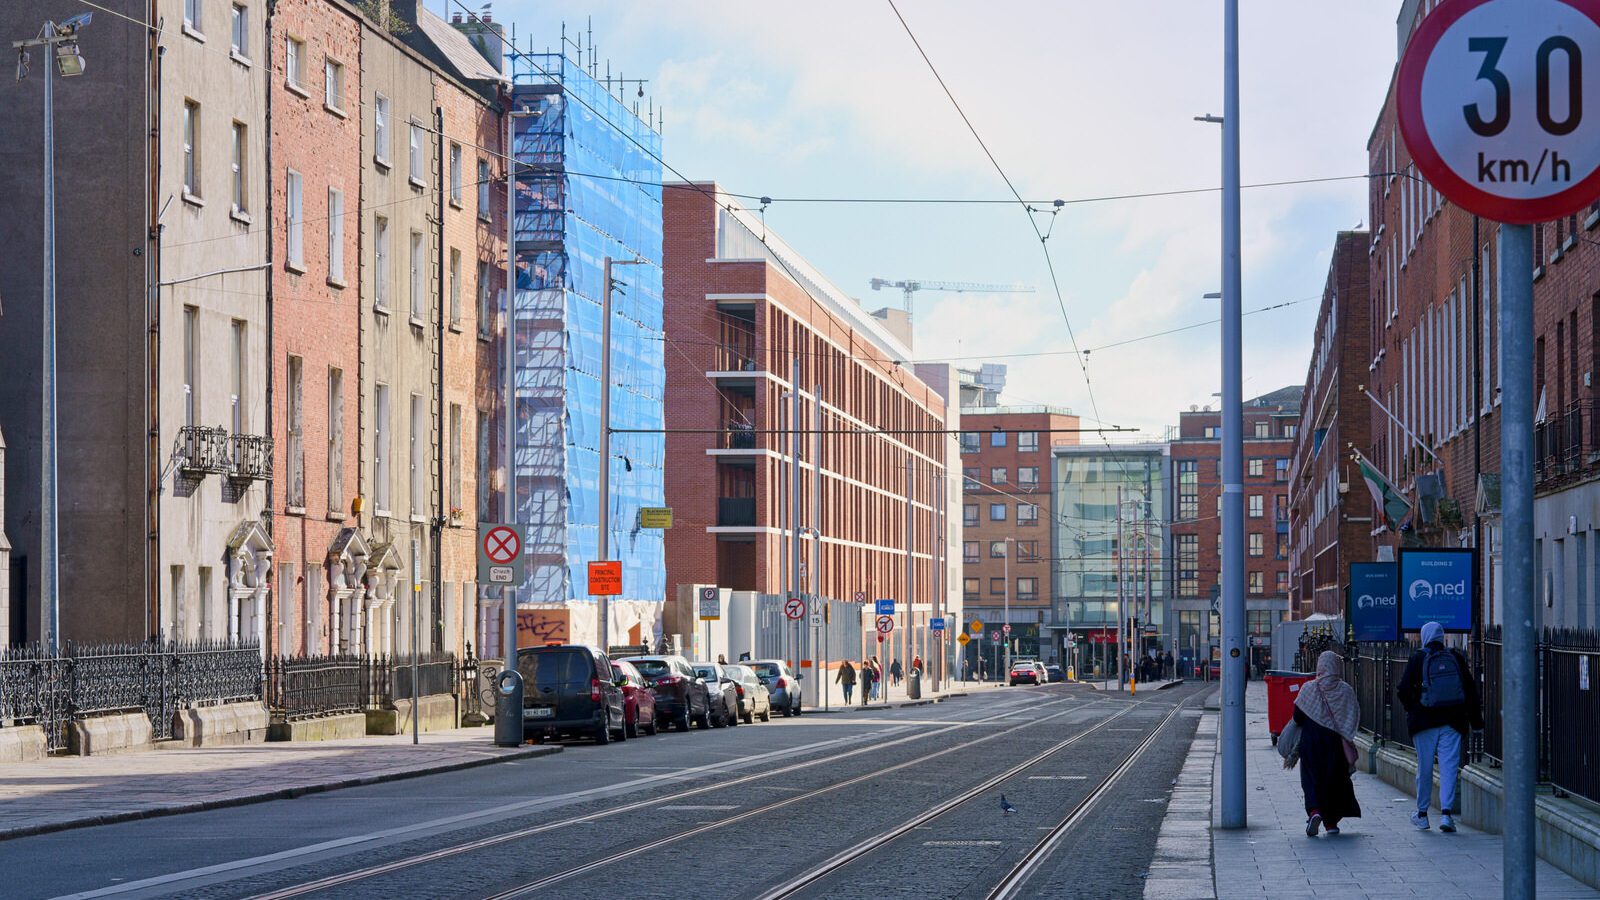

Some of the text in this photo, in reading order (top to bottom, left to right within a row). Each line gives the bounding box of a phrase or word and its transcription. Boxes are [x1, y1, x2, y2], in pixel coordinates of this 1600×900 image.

[1463, 35, 1582, 137] 30
[1477, 148, 1571, 185] km/h
[1375, 594, 1396, 605] ned
[1434, 580, 1465, 595] ned
